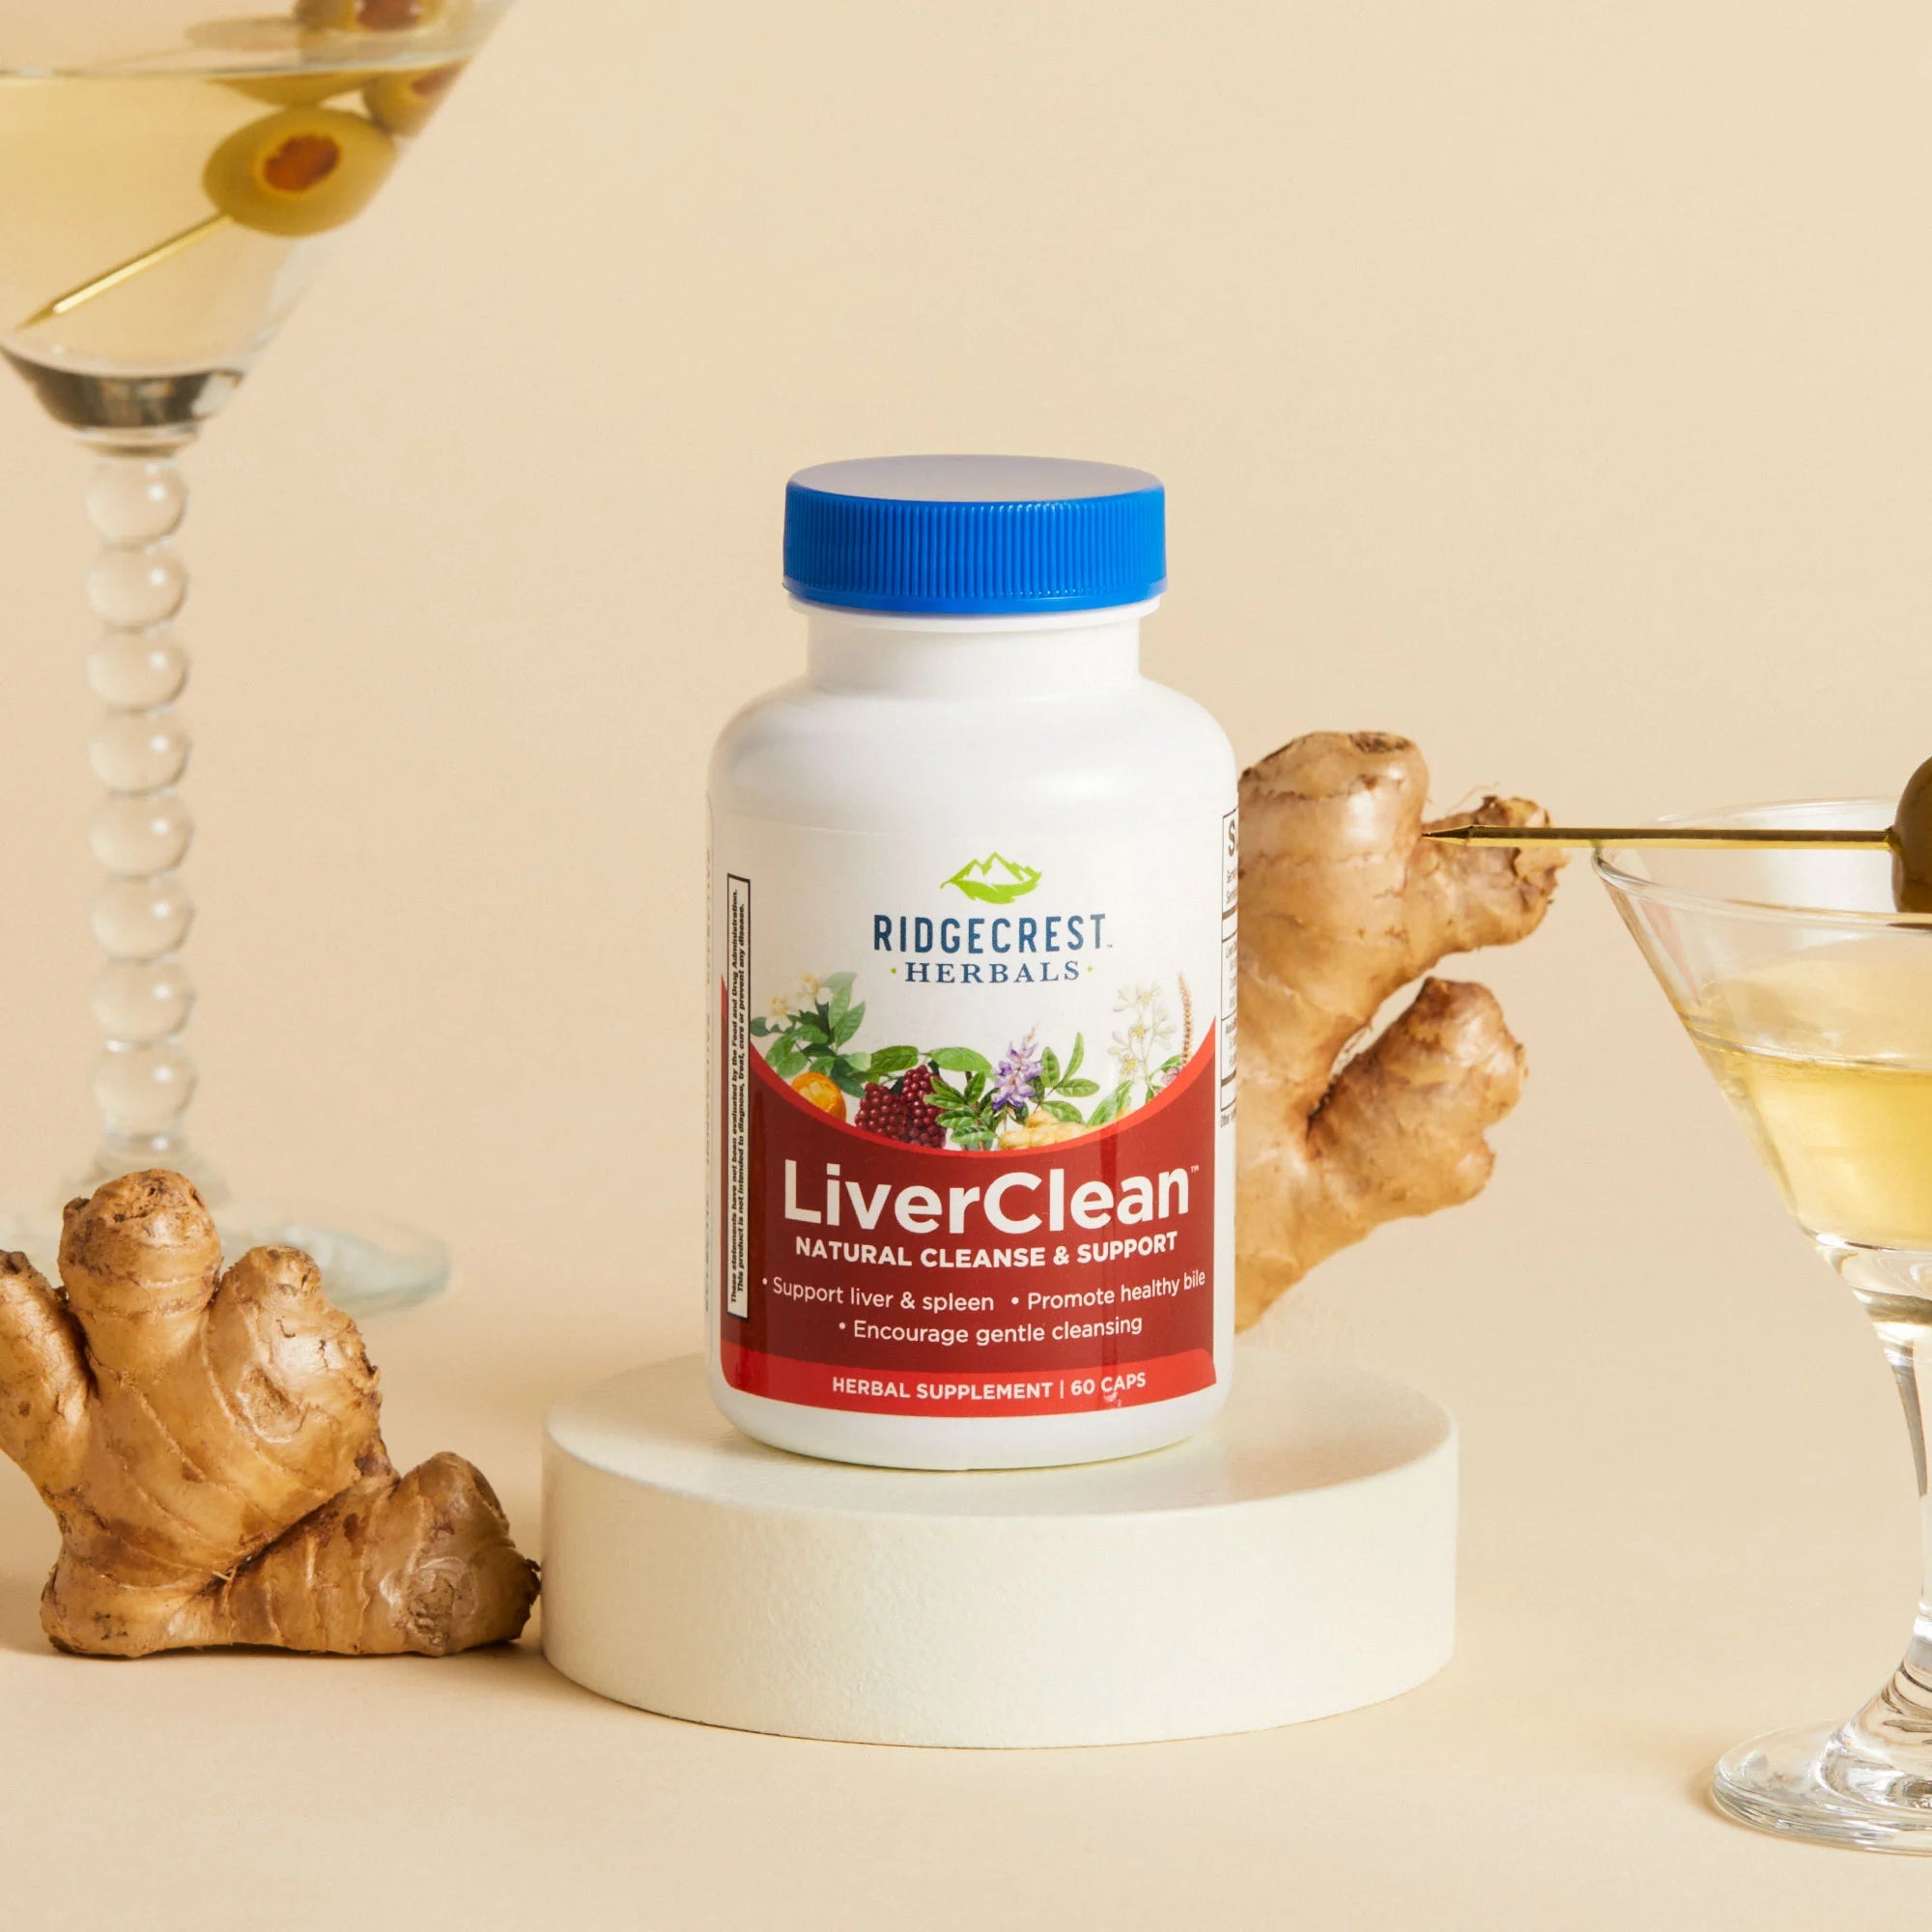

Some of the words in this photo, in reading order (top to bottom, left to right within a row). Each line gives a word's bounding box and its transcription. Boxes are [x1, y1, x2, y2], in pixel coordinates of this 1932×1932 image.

[905, 960, 1080, 983] HERBALS
[796, 1236, 912, 1266] NATURAL
[920, 1247, 1046, 1268] CLEANSE
[1053, 1246, 1070, 1265] &
[1077, 1231, 1179, 1264] SUPPORT
[773, 1276, 844, 1303] Support
[850, 1287, 895, 1308] liver
[900, 1292, 916, 1310] &
[923, 1293, 994, 1314] spleen
[1028, 1288, 1116, 1310] Promote
[1121, 1277, 1180, 1302] healthy
[1183, 1269, 1207, 1291] bile
[854, 1320, 969, 1347] Encourage
[976, 1323, 1045, 1347] gentle
[1052, 1316, 1143, 1341] cleansing
[833, 1377, 910, 1399] HERBAL
[917, 1381, 1053, 1400] SUPPLEMENT
[1071, 1378, 1095, 1396] 60
[1100, 1372, 1147, 1393] CAPS
